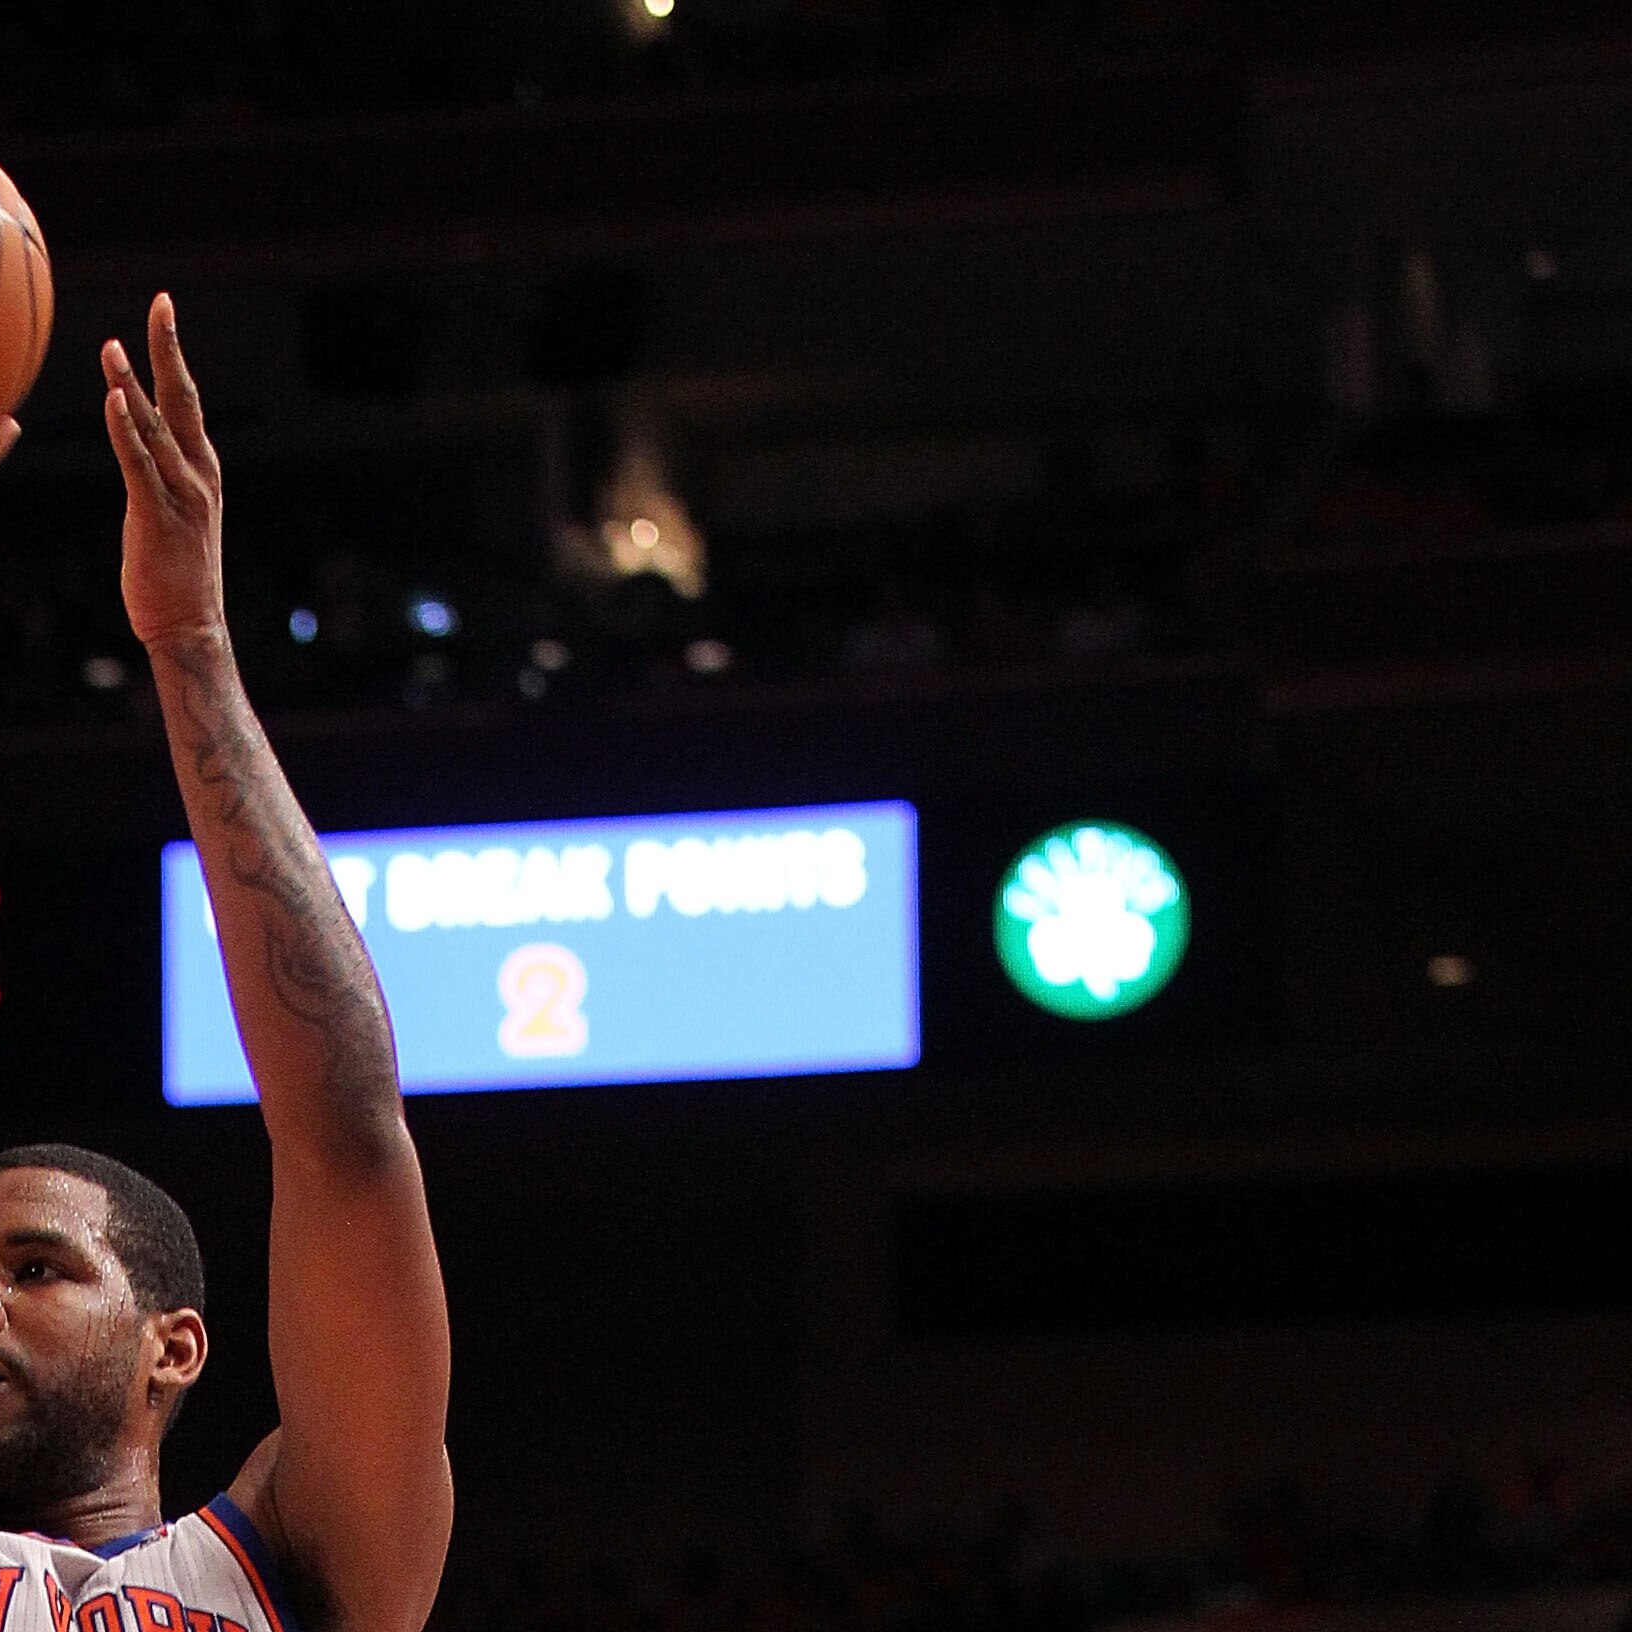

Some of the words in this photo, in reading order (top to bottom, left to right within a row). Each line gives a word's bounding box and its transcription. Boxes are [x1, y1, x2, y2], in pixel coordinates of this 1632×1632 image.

[385, 843, 614, 932] BREAK
[624, 828, 868, 918] POINTS
[498, 942, 590, 1059] 2
